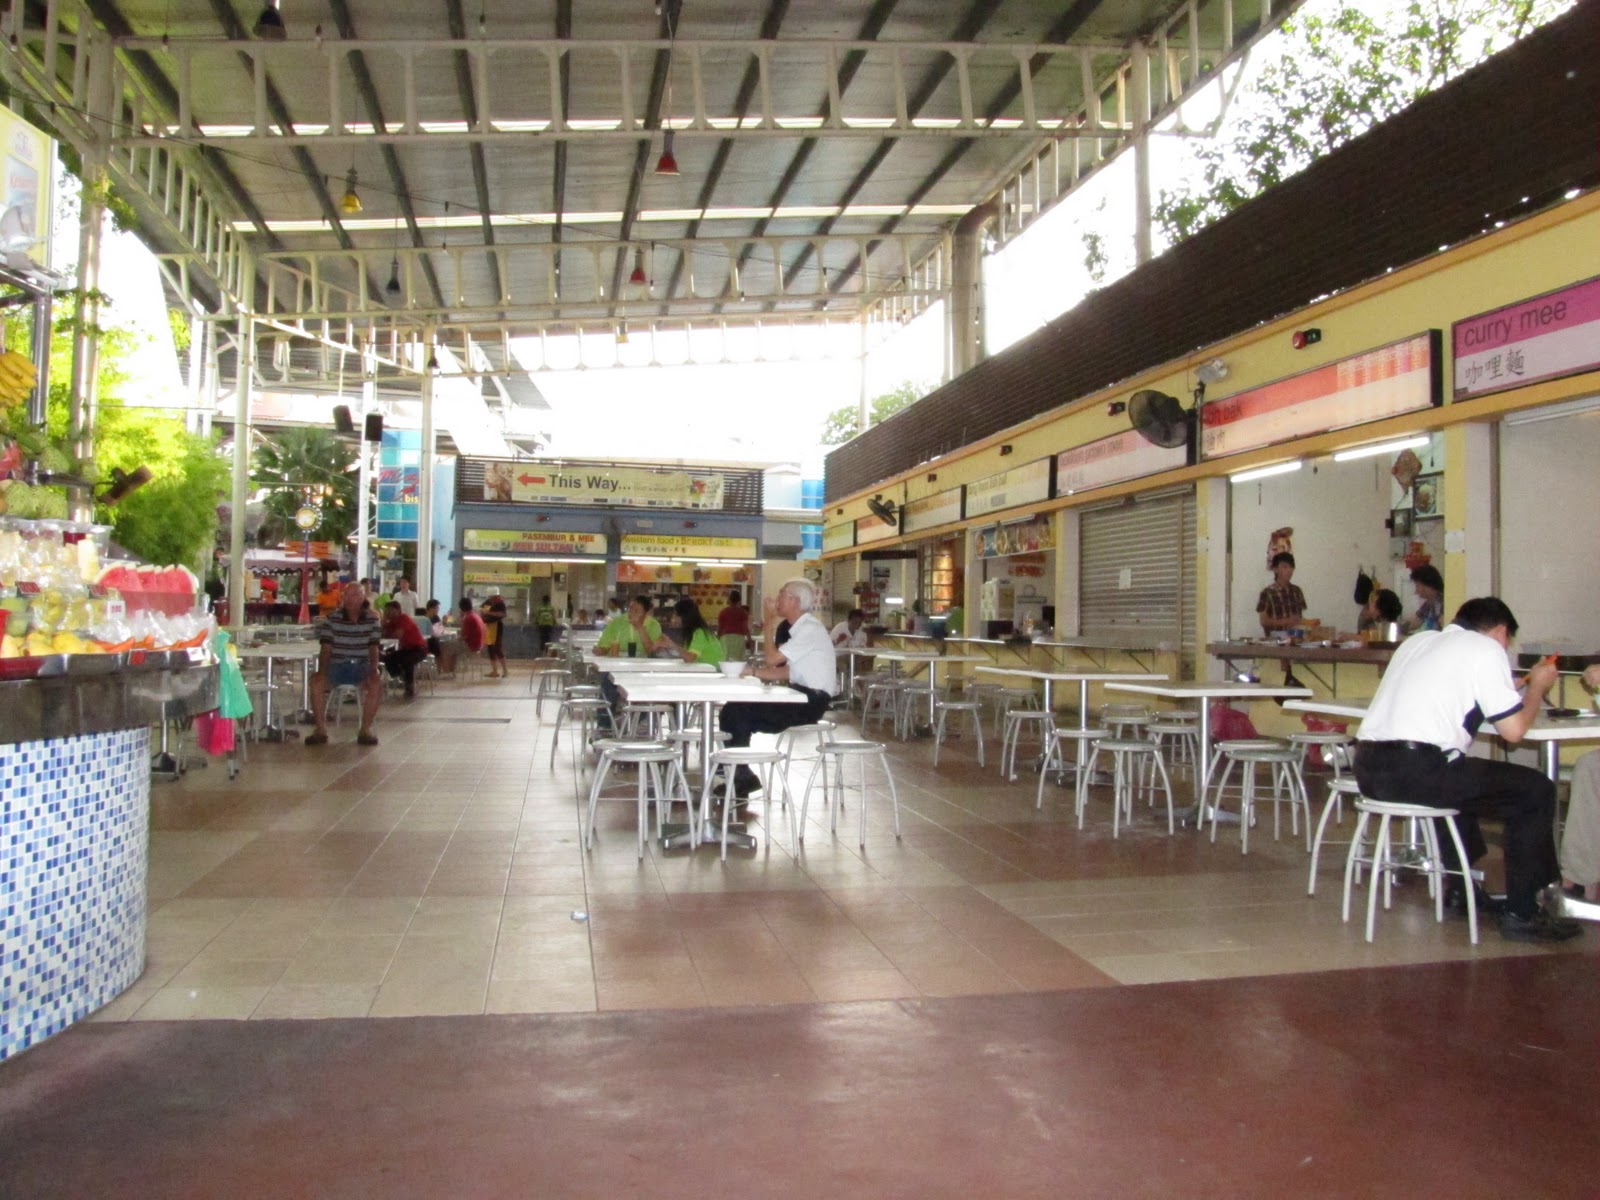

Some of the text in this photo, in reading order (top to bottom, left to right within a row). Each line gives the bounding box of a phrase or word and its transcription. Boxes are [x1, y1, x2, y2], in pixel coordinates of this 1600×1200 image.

[1464, 302, 1568, 347] curry mee
[548, 474, 582, 489] This
[587, 475, 631, 492] Way...
[522, 533, 595, 542] PASEMBUR & MEE
[657, 536, 674, 545] food
